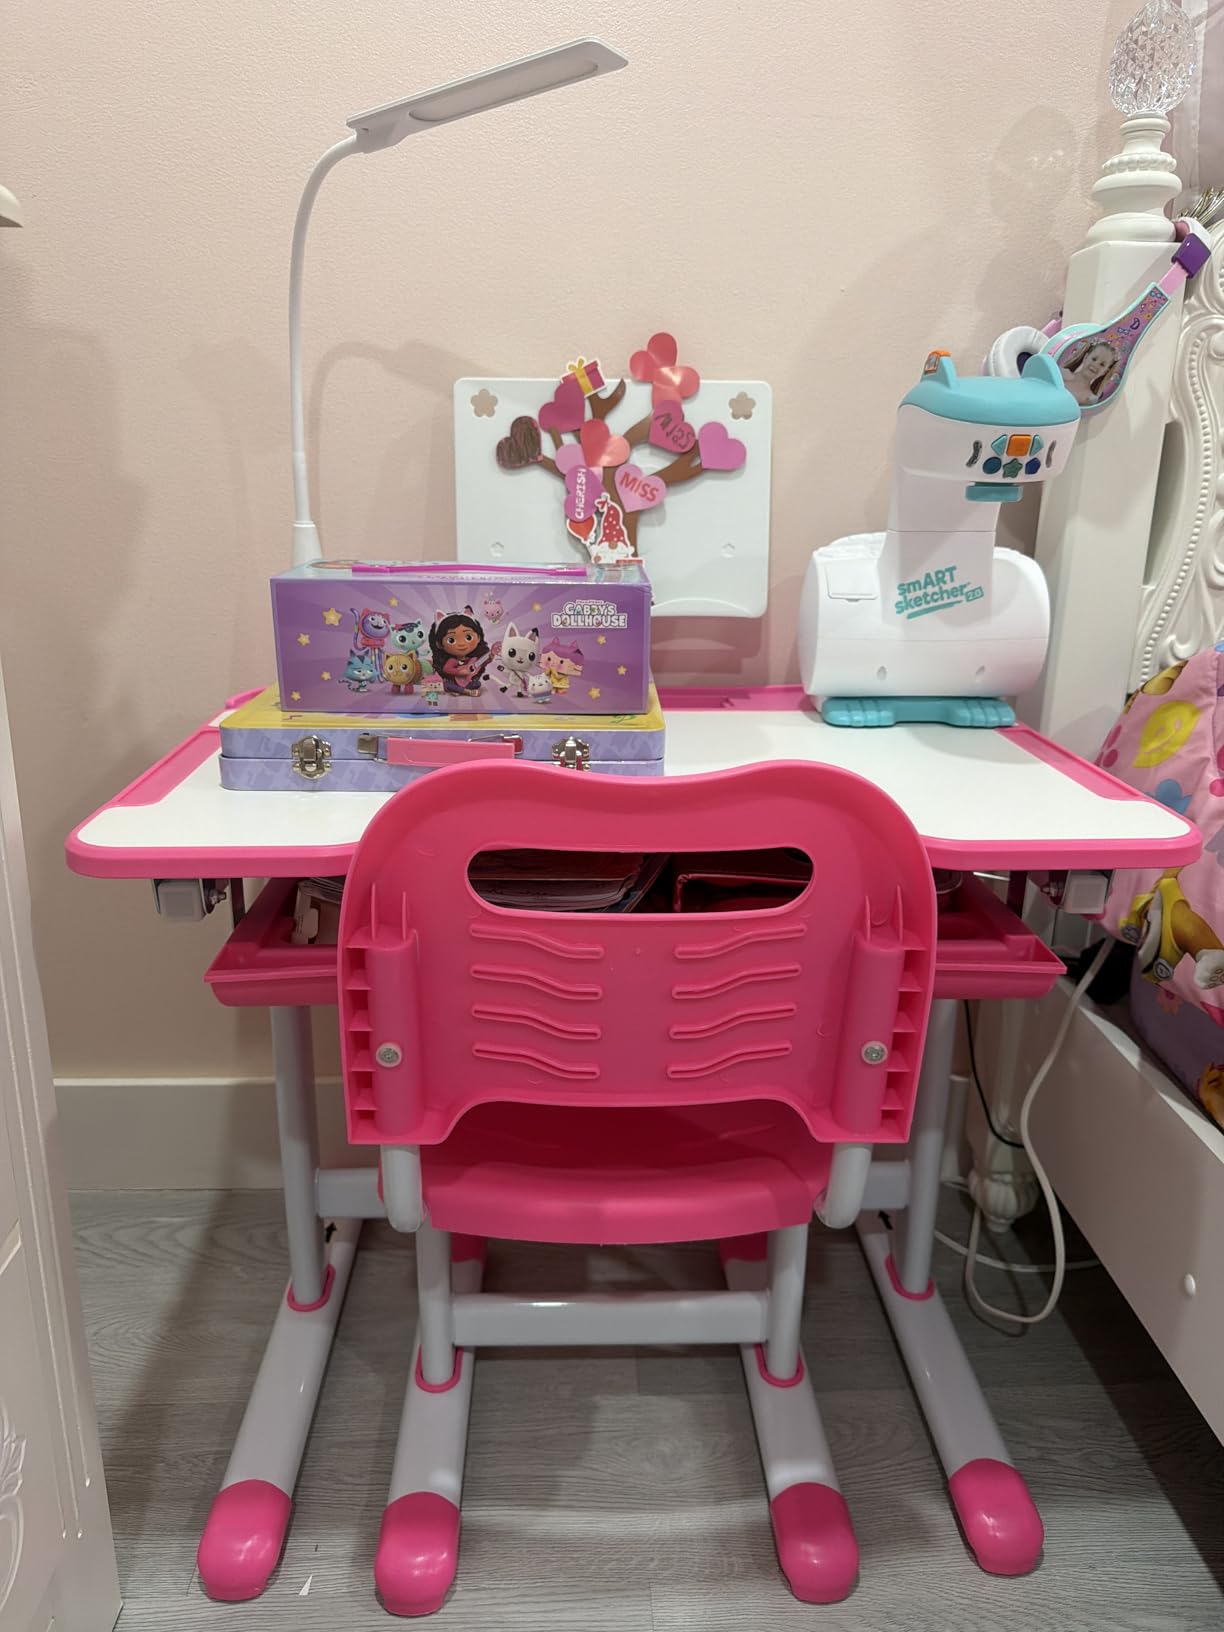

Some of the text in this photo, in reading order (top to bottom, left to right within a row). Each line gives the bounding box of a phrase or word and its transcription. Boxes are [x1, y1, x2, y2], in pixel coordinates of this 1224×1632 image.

[574, 468, 587, 519] CHERISH
[620, 471, 660, 502] MISS
[897, 565, 957, 596] smART
[563, 602, 616, 615] GABBY'S
[895, 583, 967, 614] sketcher
[552, 614, 627, 627] DOLLHOUSE
